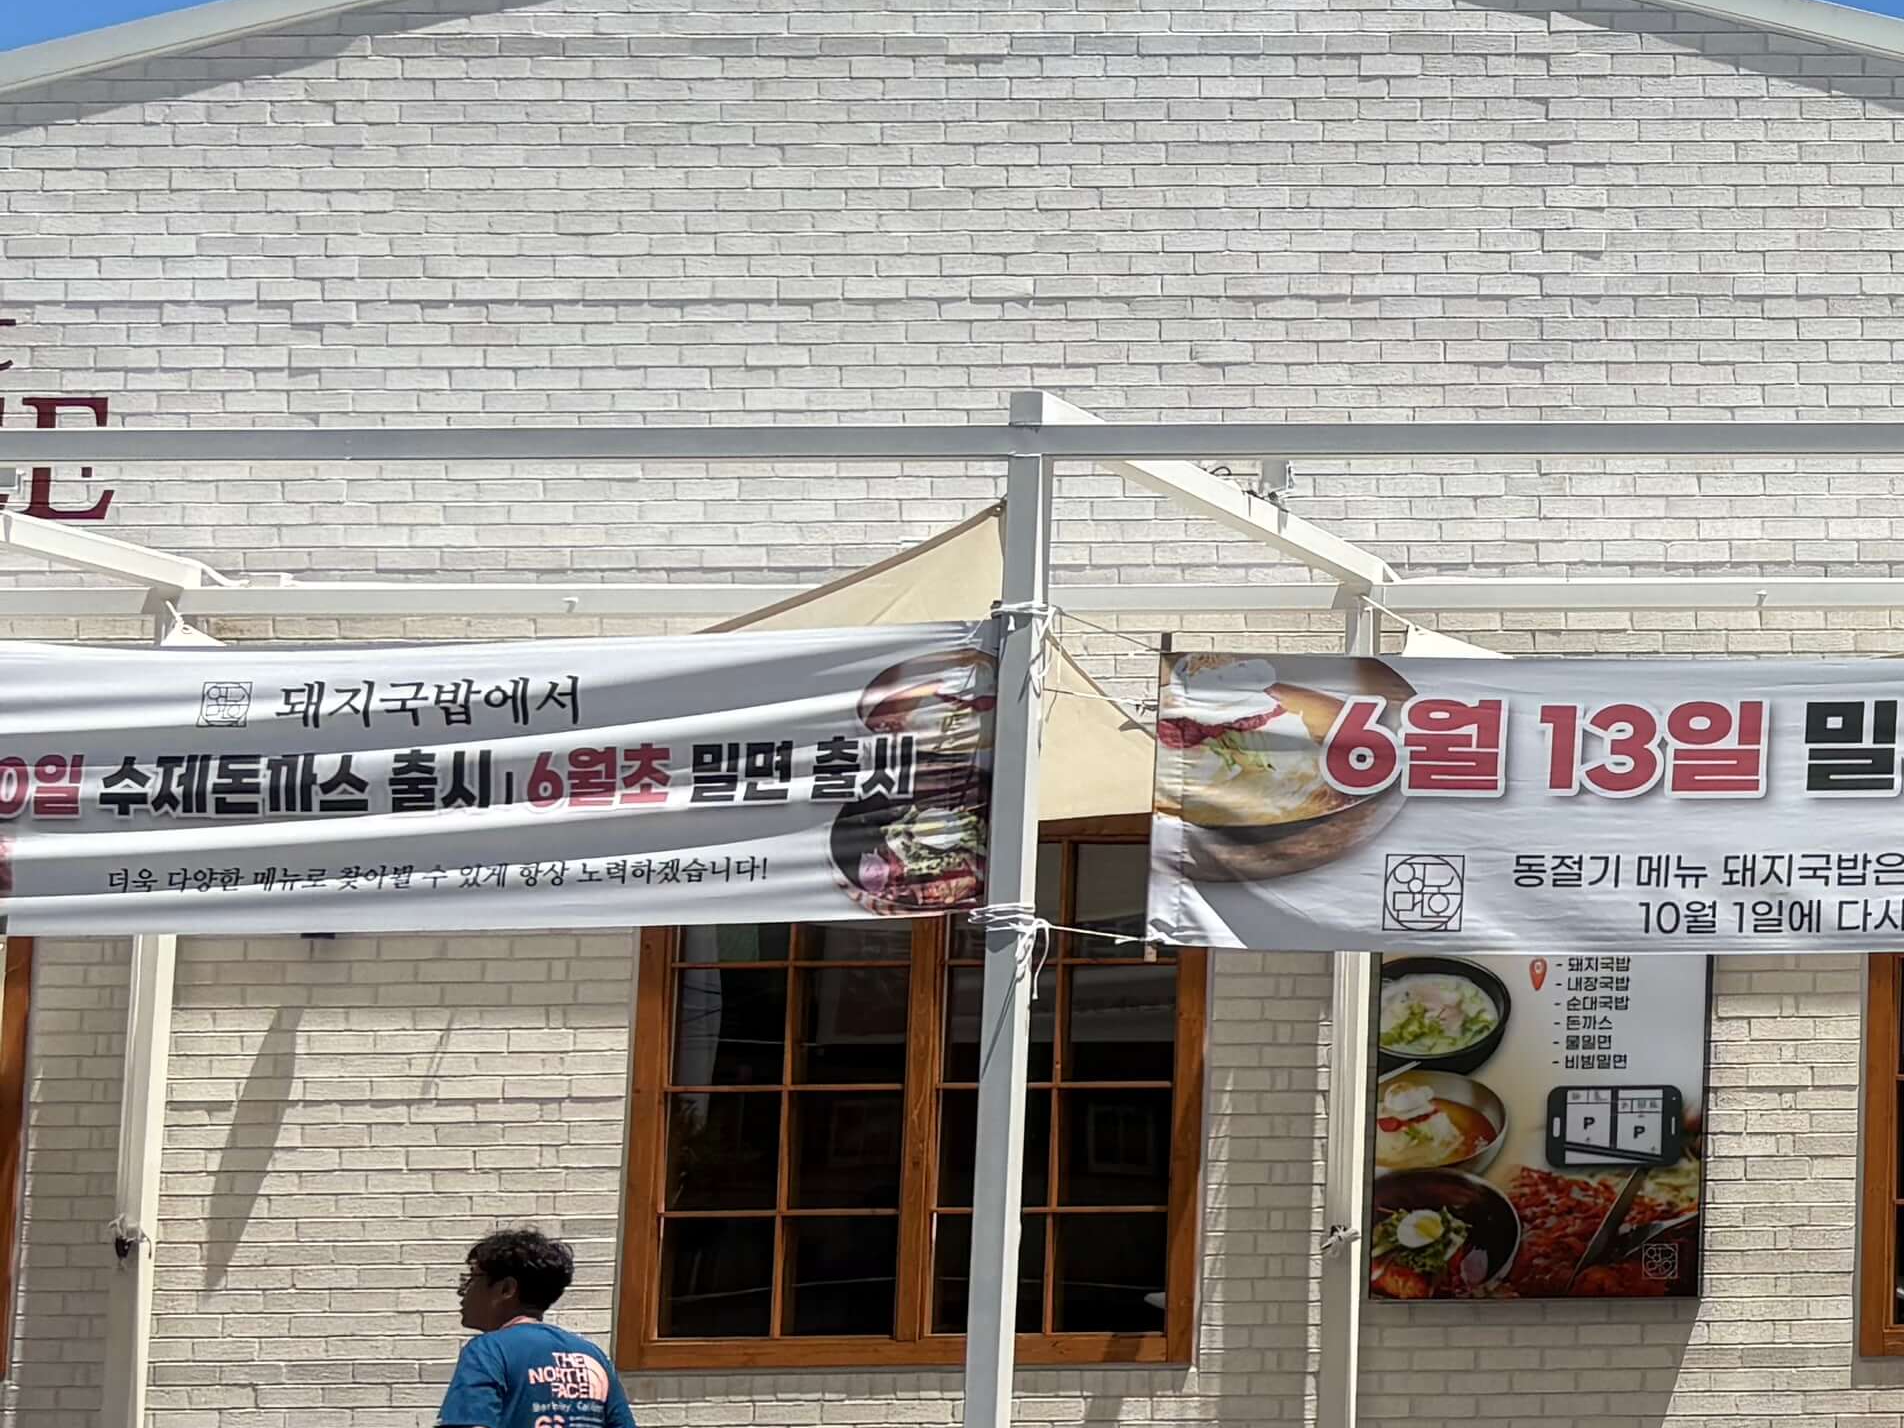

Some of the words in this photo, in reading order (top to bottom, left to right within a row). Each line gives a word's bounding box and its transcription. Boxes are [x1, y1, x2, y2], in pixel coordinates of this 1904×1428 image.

[275, 675, 580, 728] 돼지국밥에서
[1325, 698, 1503, 791] 6월
[1539, 699, 1765, 793] 13일
[100, 753, 370, 816] 수제돈까스
[690, 739, 794, 803] 밀면
[810, 734, 915, 801] 출시
[107, 869, 158, 893] 더욱
[167, 867, 244, 893] 다양한
[253, 866, 328, 892] 메뉴로
[423, 865, 449, 890] 수
[459, 863, 507, 889] 있게
[519, 861, 569, 887] 항상
[576, 855, 768, 886] 노력하겠습니다!
[1512, 853, 1621, 889] 동절기
[1636, 853, 1708, 889] 메뉴
[1638, 899, 1718, 934] 10월
[1733, 898, 1821, 934] 1일에
[1567, 956, 1631, 972] 돼지국밥
[1567, 976, 1630, 992] 내장국밥
[1566, 996, 1630, 1011] 순대국밥
[1565, 1015, 1613, 1031] 돈까스
[1583, 1116, 1596, 1130] P
[1633, 1125, 1645, 1139] P
[552, 1352, 585, 1368] THE
[528, 1366, 590, 1385] NORTH
[550, 1382, 590, 1399] FACE
